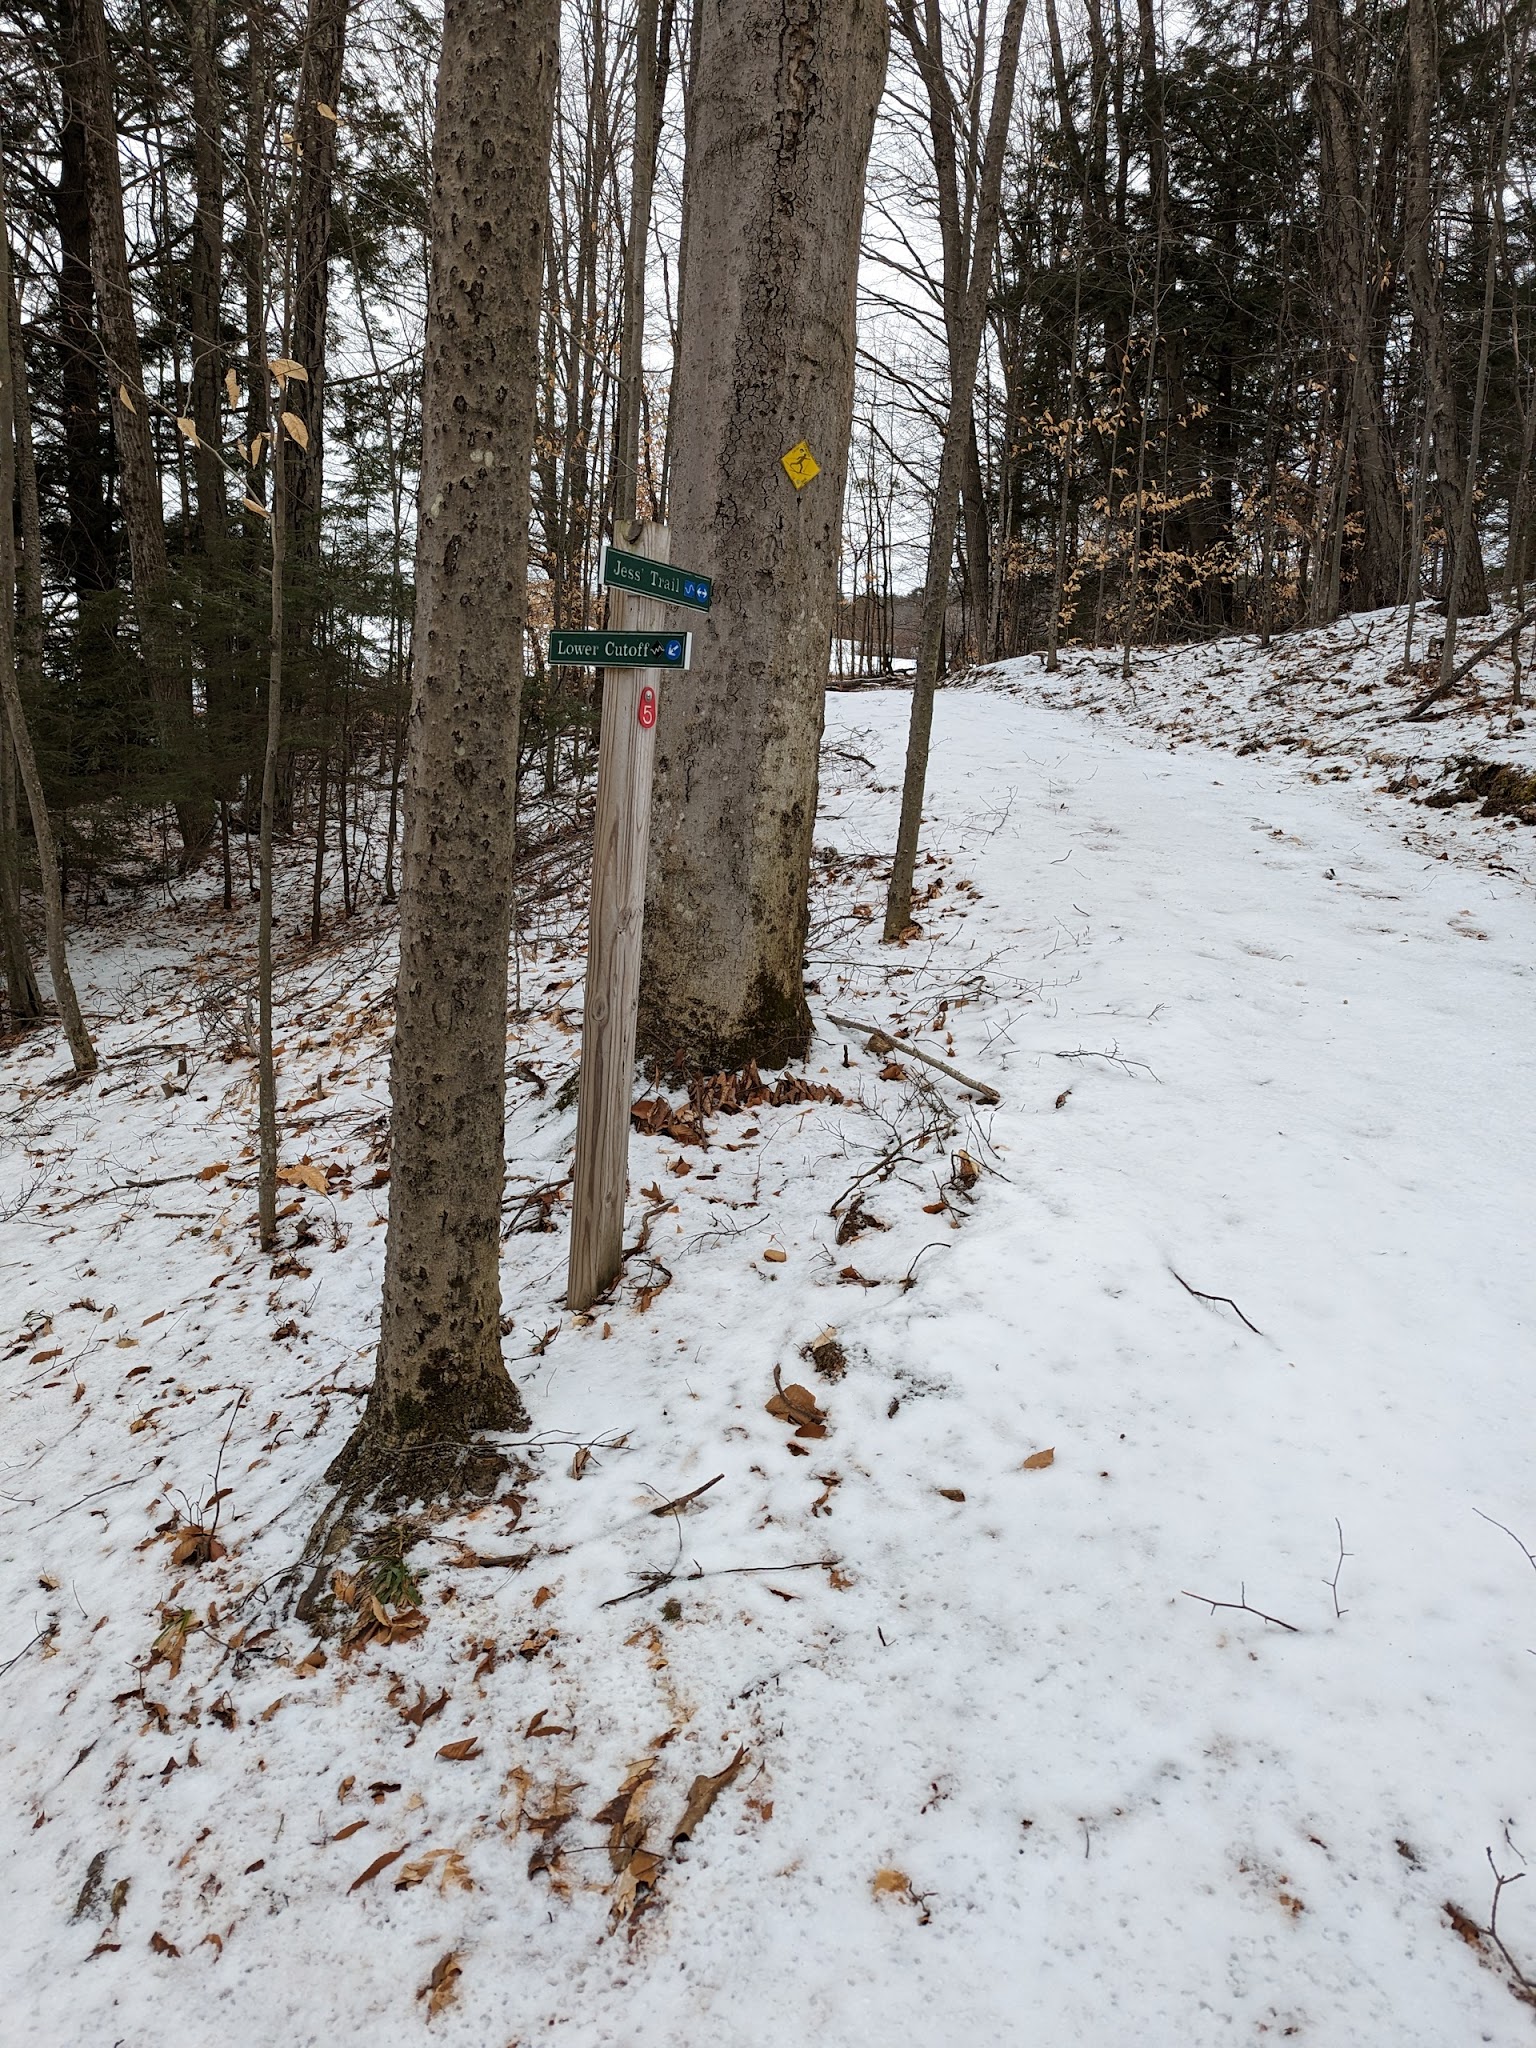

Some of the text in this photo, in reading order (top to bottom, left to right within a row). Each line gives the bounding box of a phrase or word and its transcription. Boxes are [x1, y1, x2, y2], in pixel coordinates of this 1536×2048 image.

[650, 570, 680, 593] Trail
[557, 640, 650, 657] Lower Cutoff
[642, 705, 653, 725] 5
